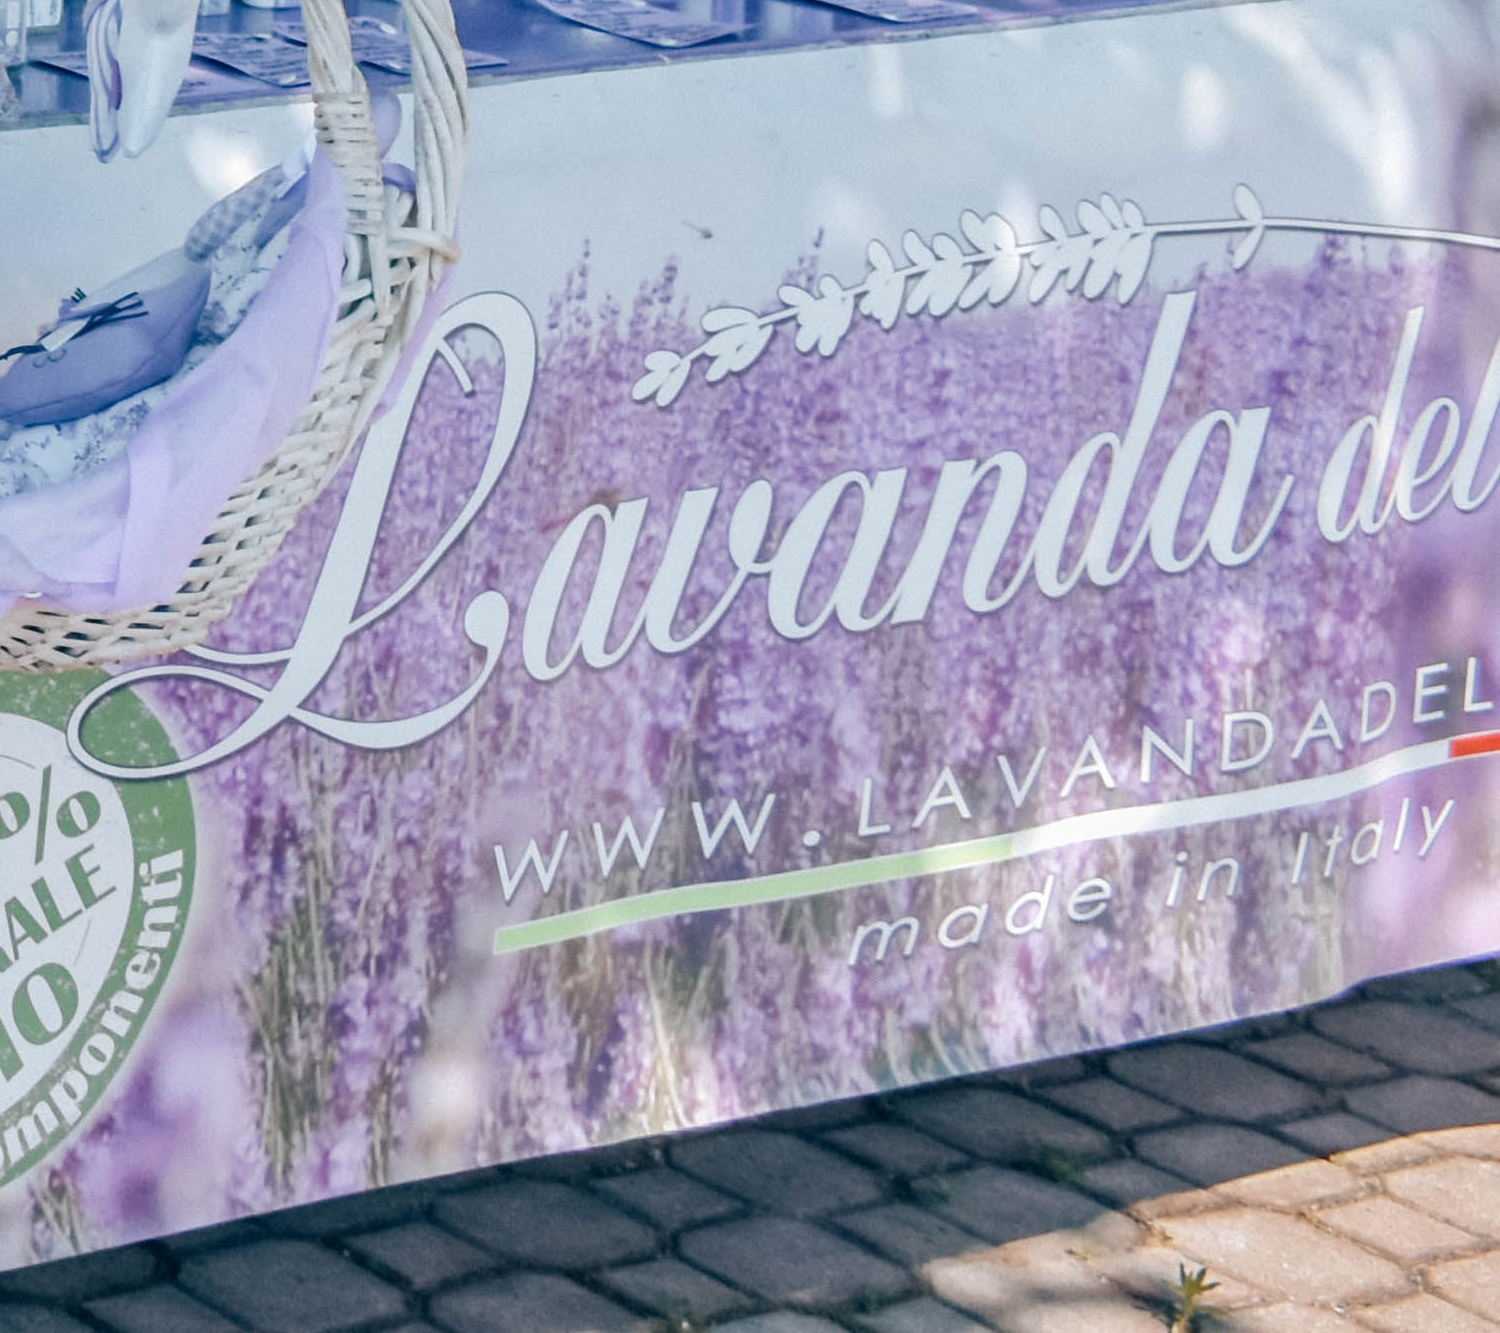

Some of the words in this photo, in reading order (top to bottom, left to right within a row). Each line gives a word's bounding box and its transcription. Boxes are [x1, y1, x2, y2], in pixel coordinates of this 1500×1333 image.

[66, 290, 1293, 780] Lavanda
[848, 876, 1108, 965] made
[1166, 851, 1239, 909] in
[1291, 799, 1454, 885] Italy
